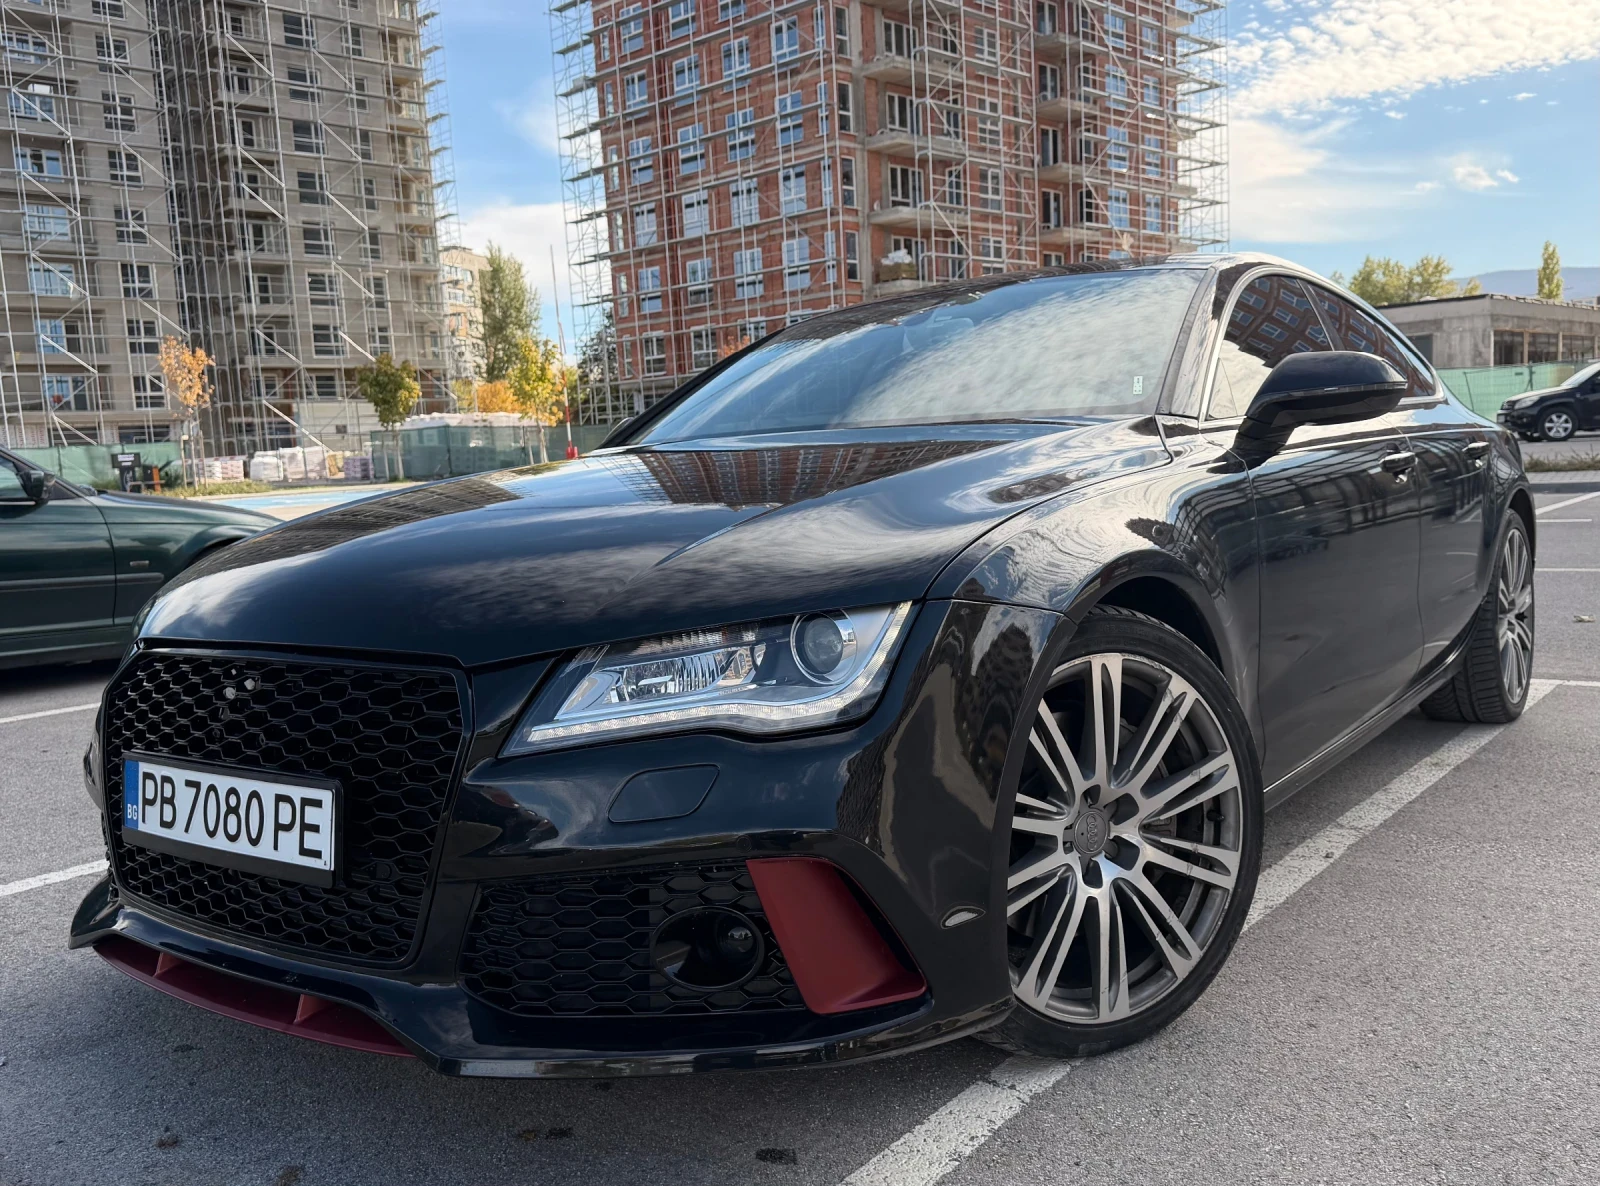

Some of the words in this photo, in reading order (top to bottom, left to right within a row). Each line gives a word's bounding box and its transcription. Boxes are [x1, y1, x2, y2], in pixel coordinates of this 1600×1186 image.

[127, 803, 138, 820] BG
[141, 771, 177, 829] PB
[184, 779, 265, 847] 7080
[273, 793, 323, 859] PE
